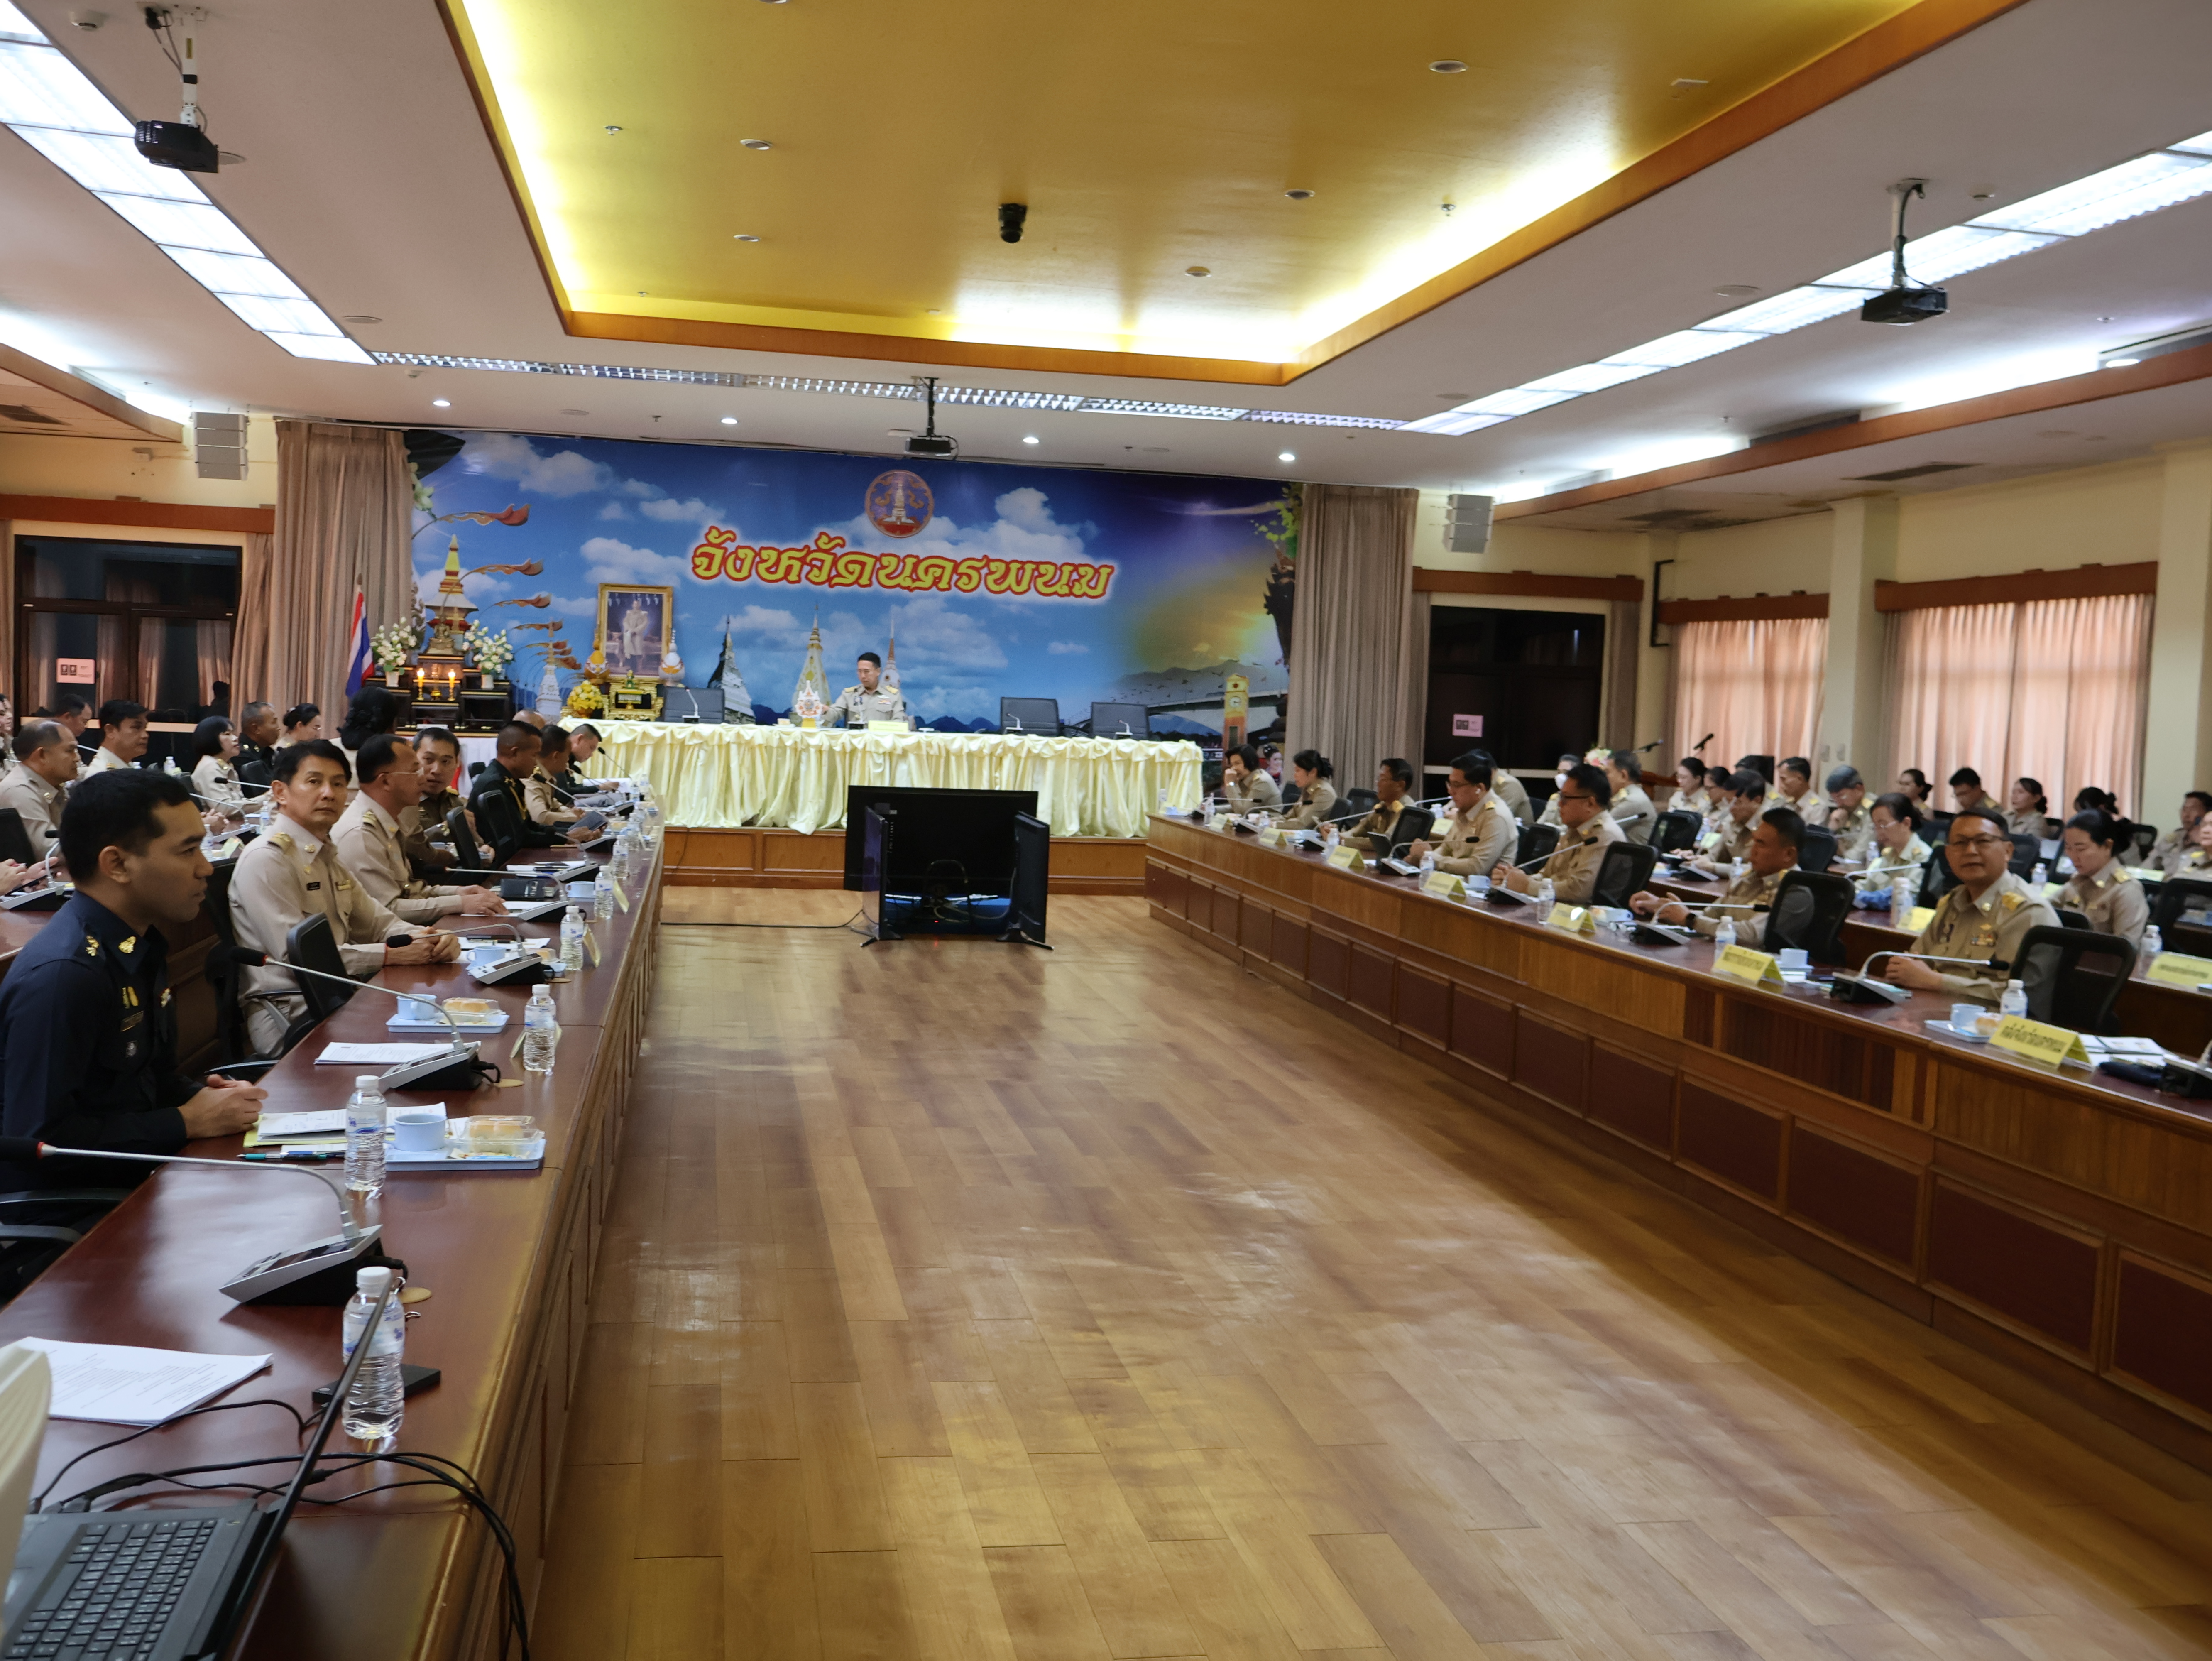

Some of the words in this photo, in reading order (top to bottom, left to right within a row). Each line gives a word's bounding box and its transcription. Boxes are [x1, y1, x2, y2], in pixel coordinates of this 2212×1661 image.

[692, 526, 1114, 599] จังหวัดนครพนม
